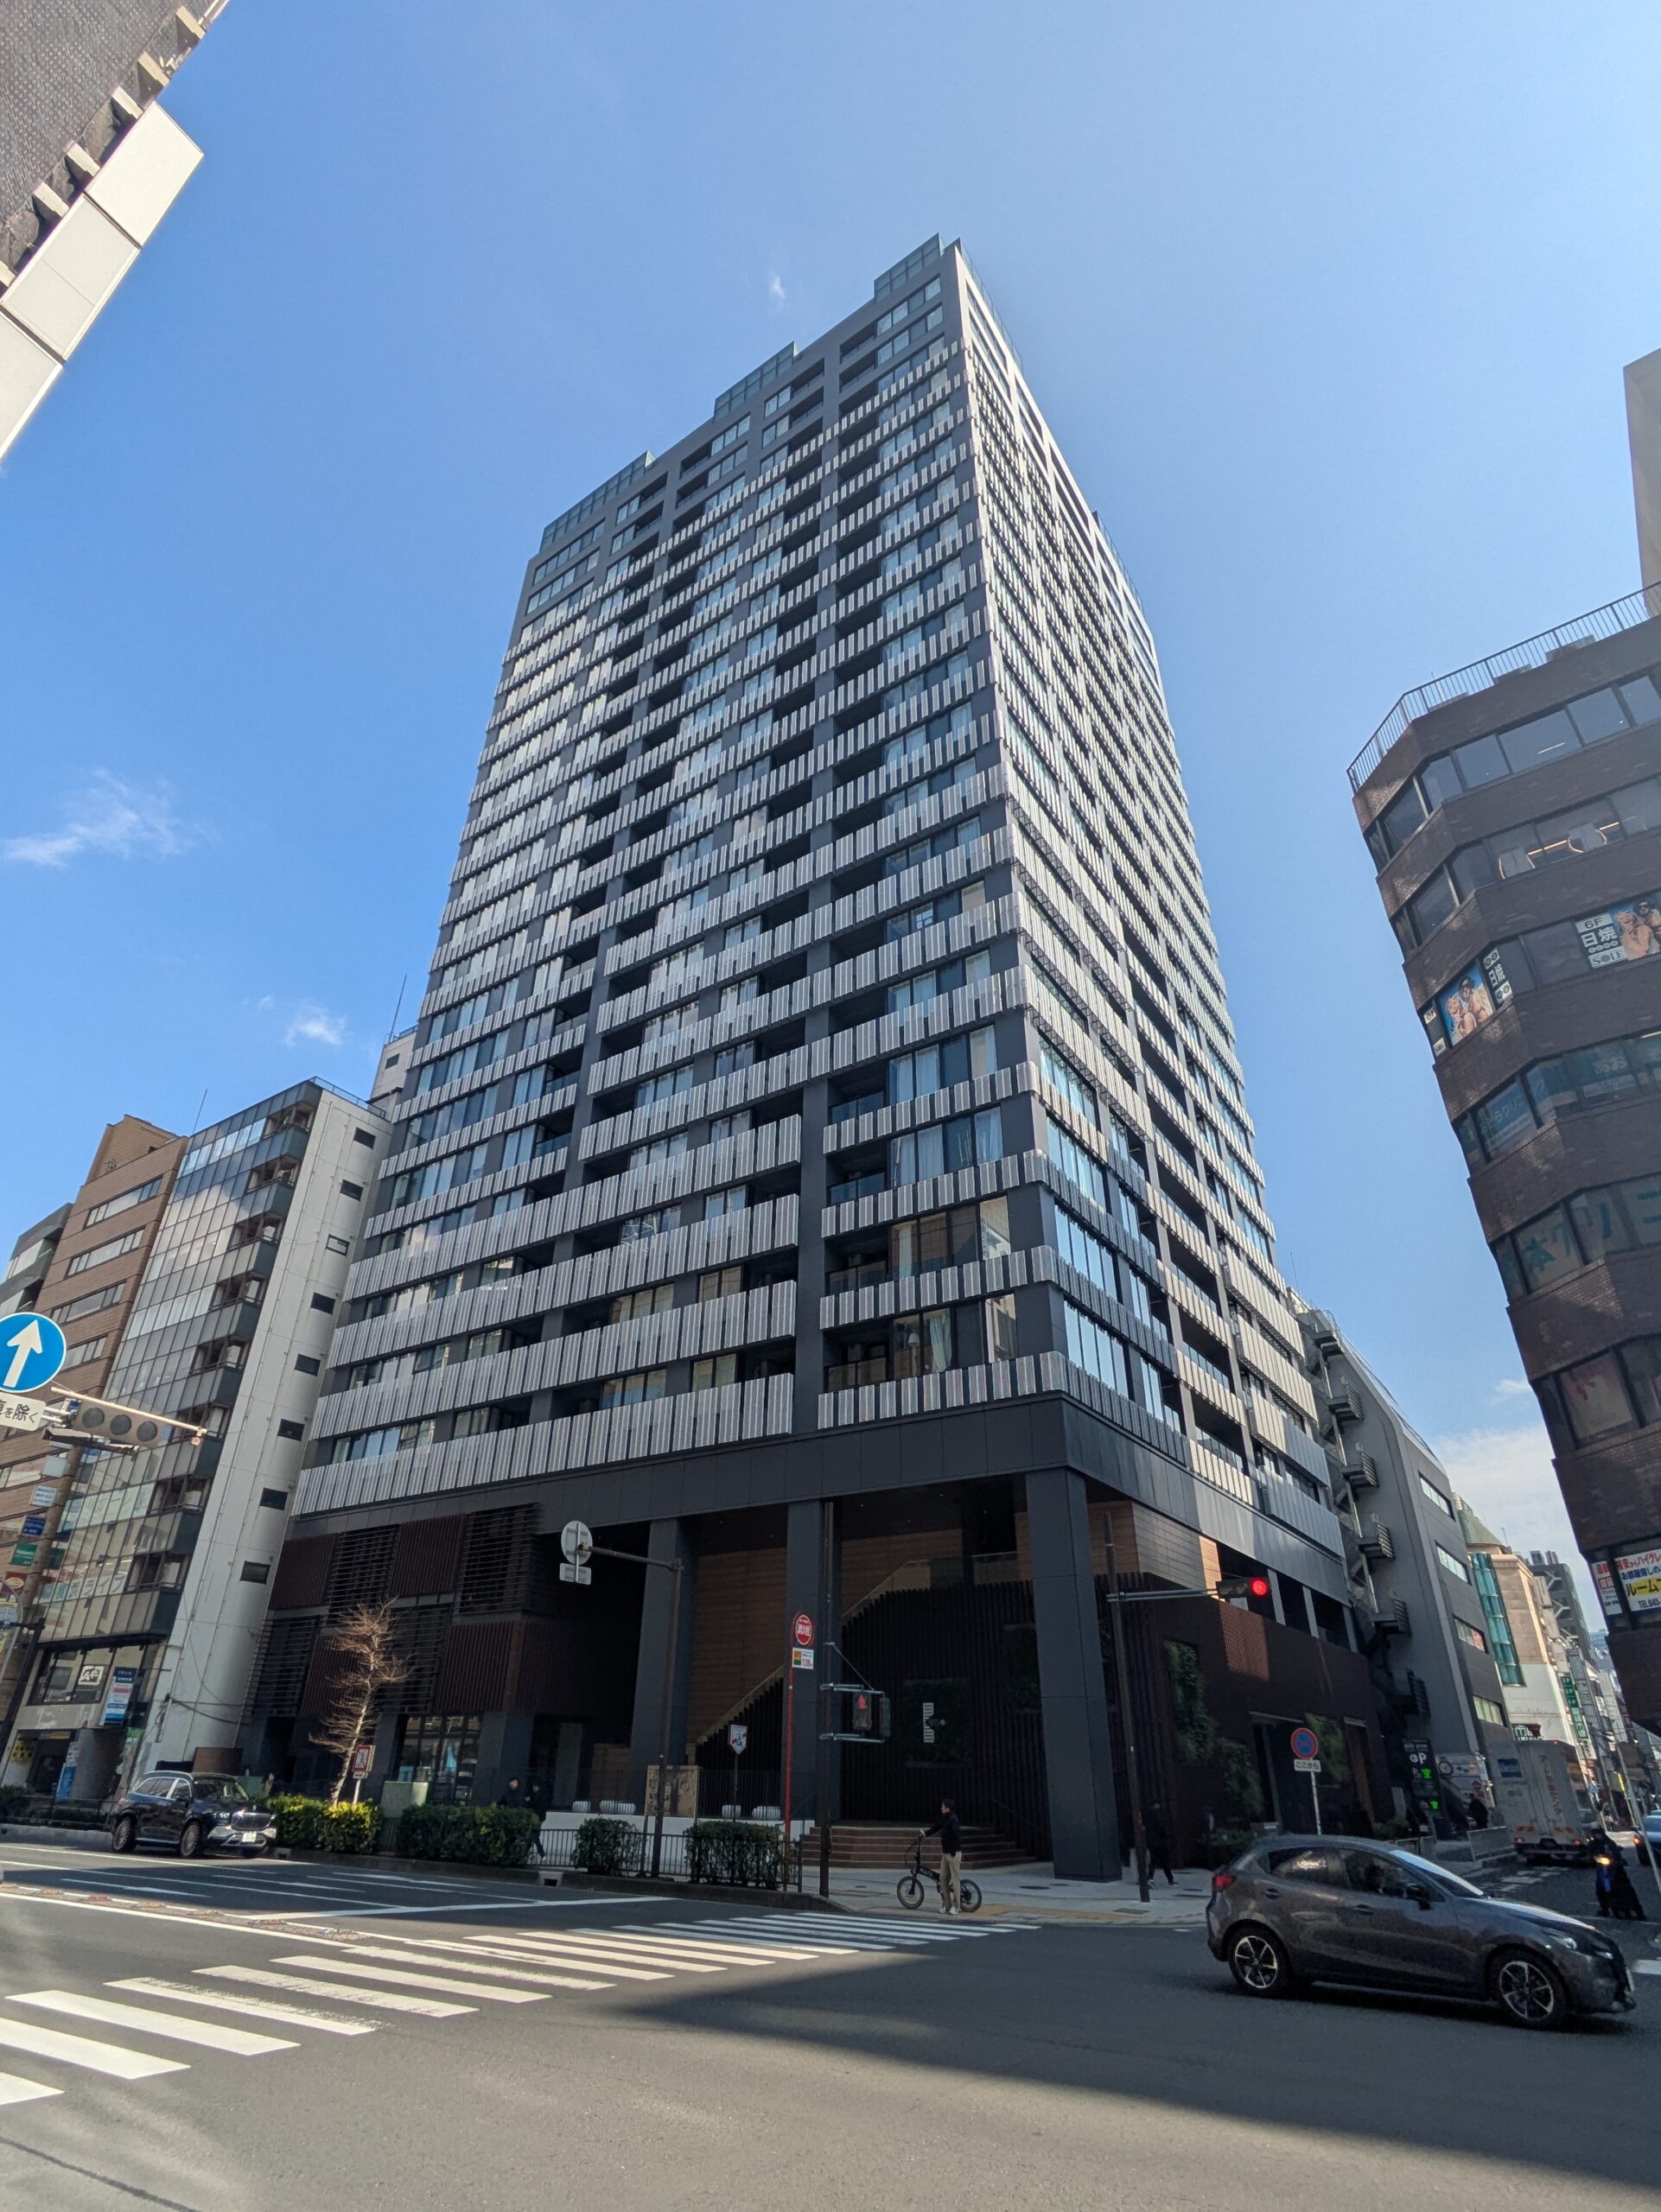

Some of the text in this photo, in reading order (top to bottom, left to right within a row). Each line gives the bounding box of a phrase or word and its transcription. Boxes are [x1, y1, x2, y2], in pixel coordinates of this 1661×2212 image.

[1584, 918, 1602, 929] 6F
[1626, 1578, 1661, 1597] ルーム
[1295, 1761, 1320, 1770] ここから
